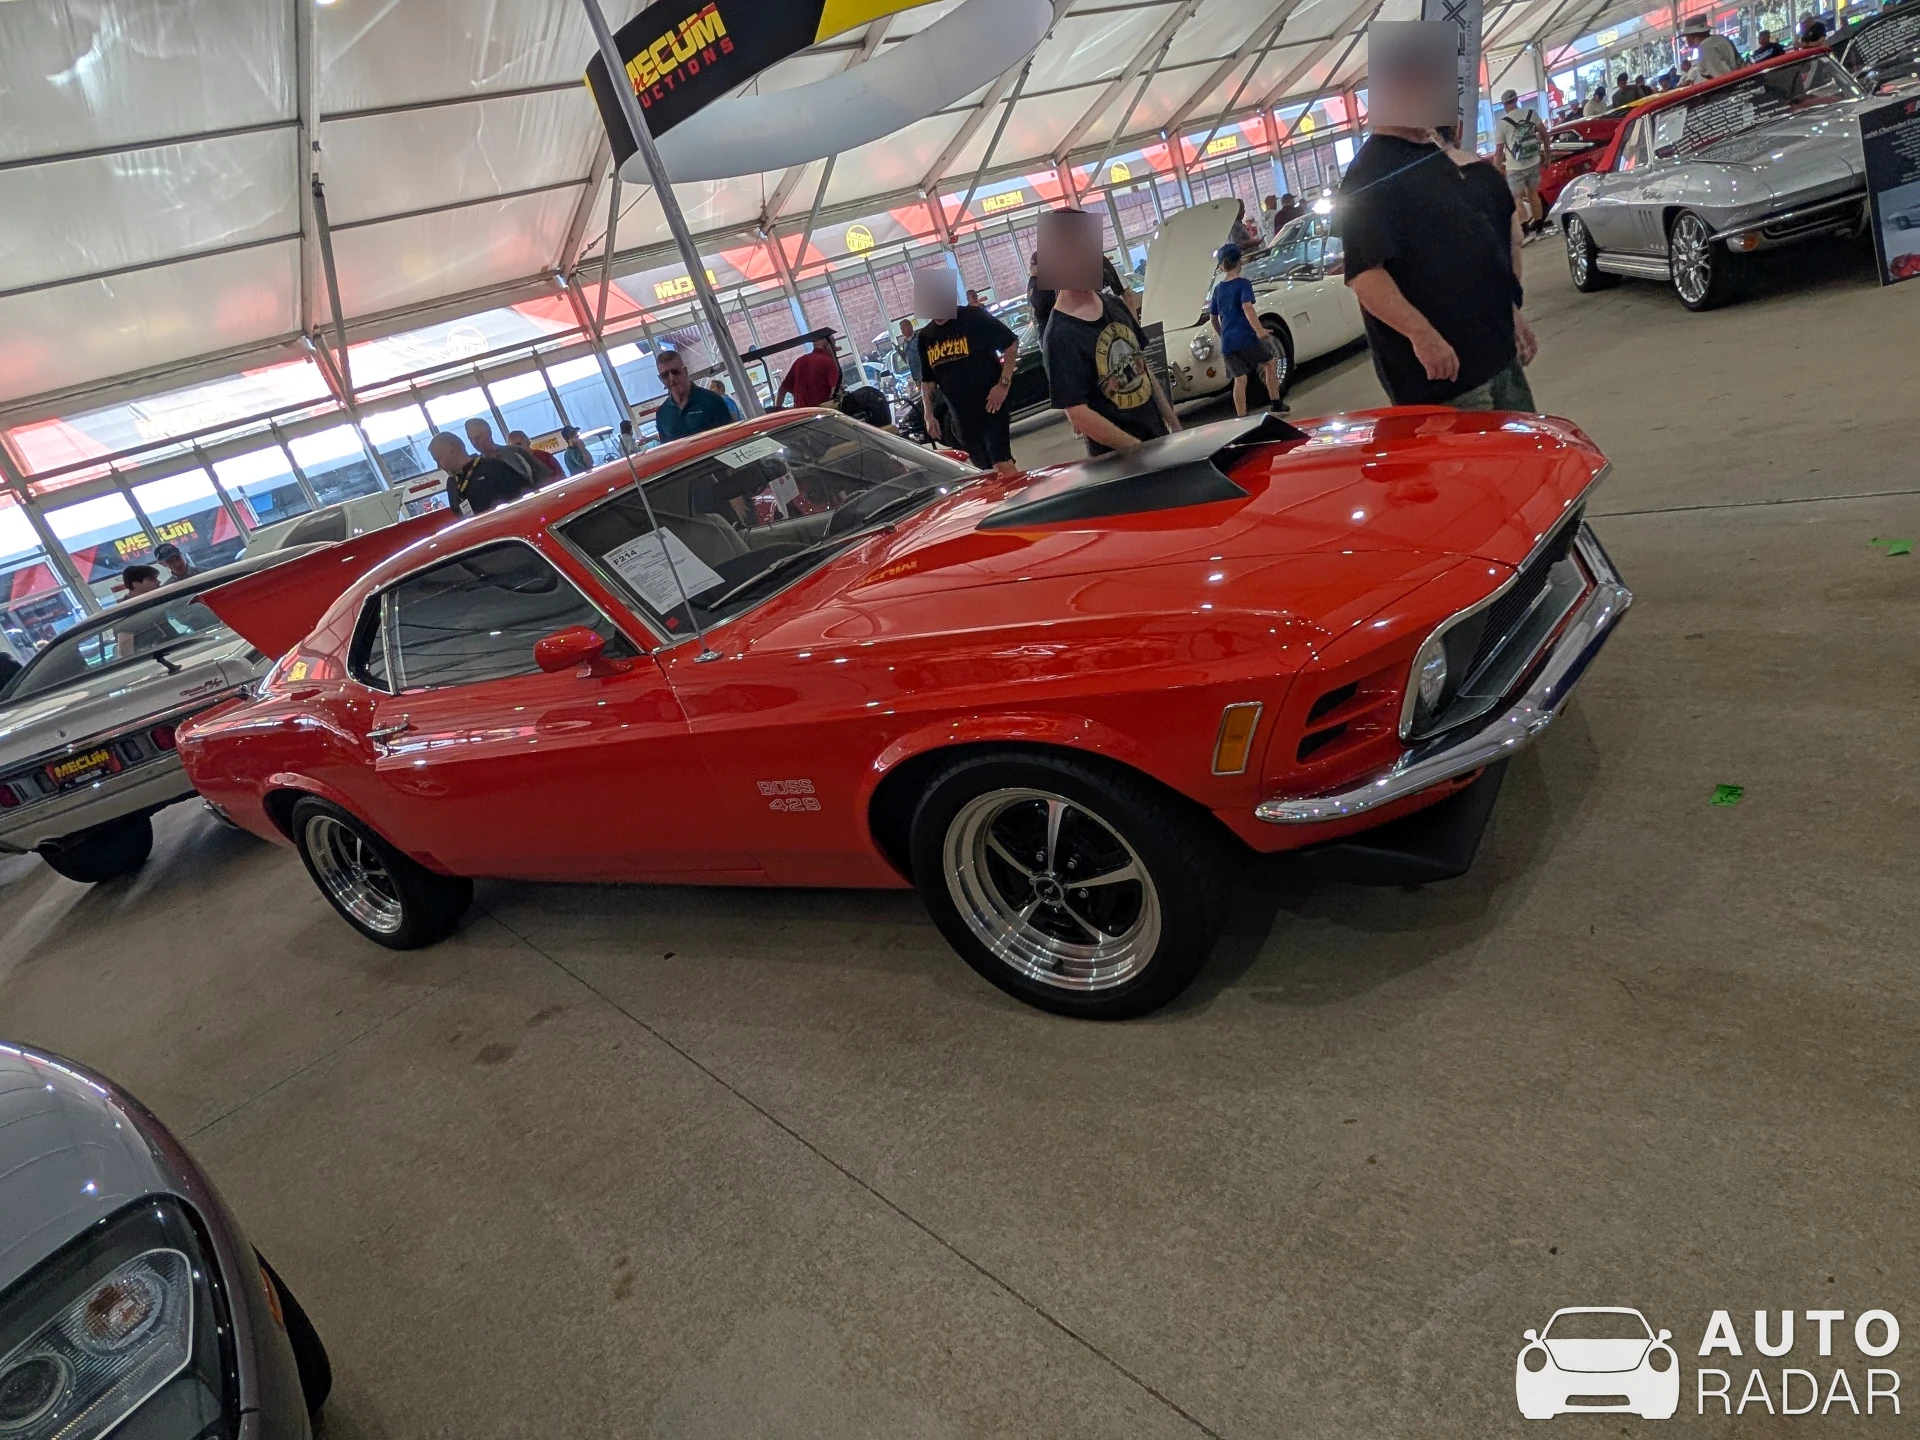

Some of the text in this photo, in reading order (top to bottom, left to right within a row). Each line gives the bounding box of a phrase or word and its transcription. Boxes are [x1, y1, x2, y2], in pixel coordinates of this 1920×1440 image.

[640, 36, 734, 109] UCTIONS
[115, 519, 195, 555] MEUM
[121, 532, 199, 561] AUCONS
[612, 549, 638, 566] F214
[54, 749, 110, 778] MECUM
[757, 778, 816, 796] BOSS
[768, 797, 821, 812] 429
